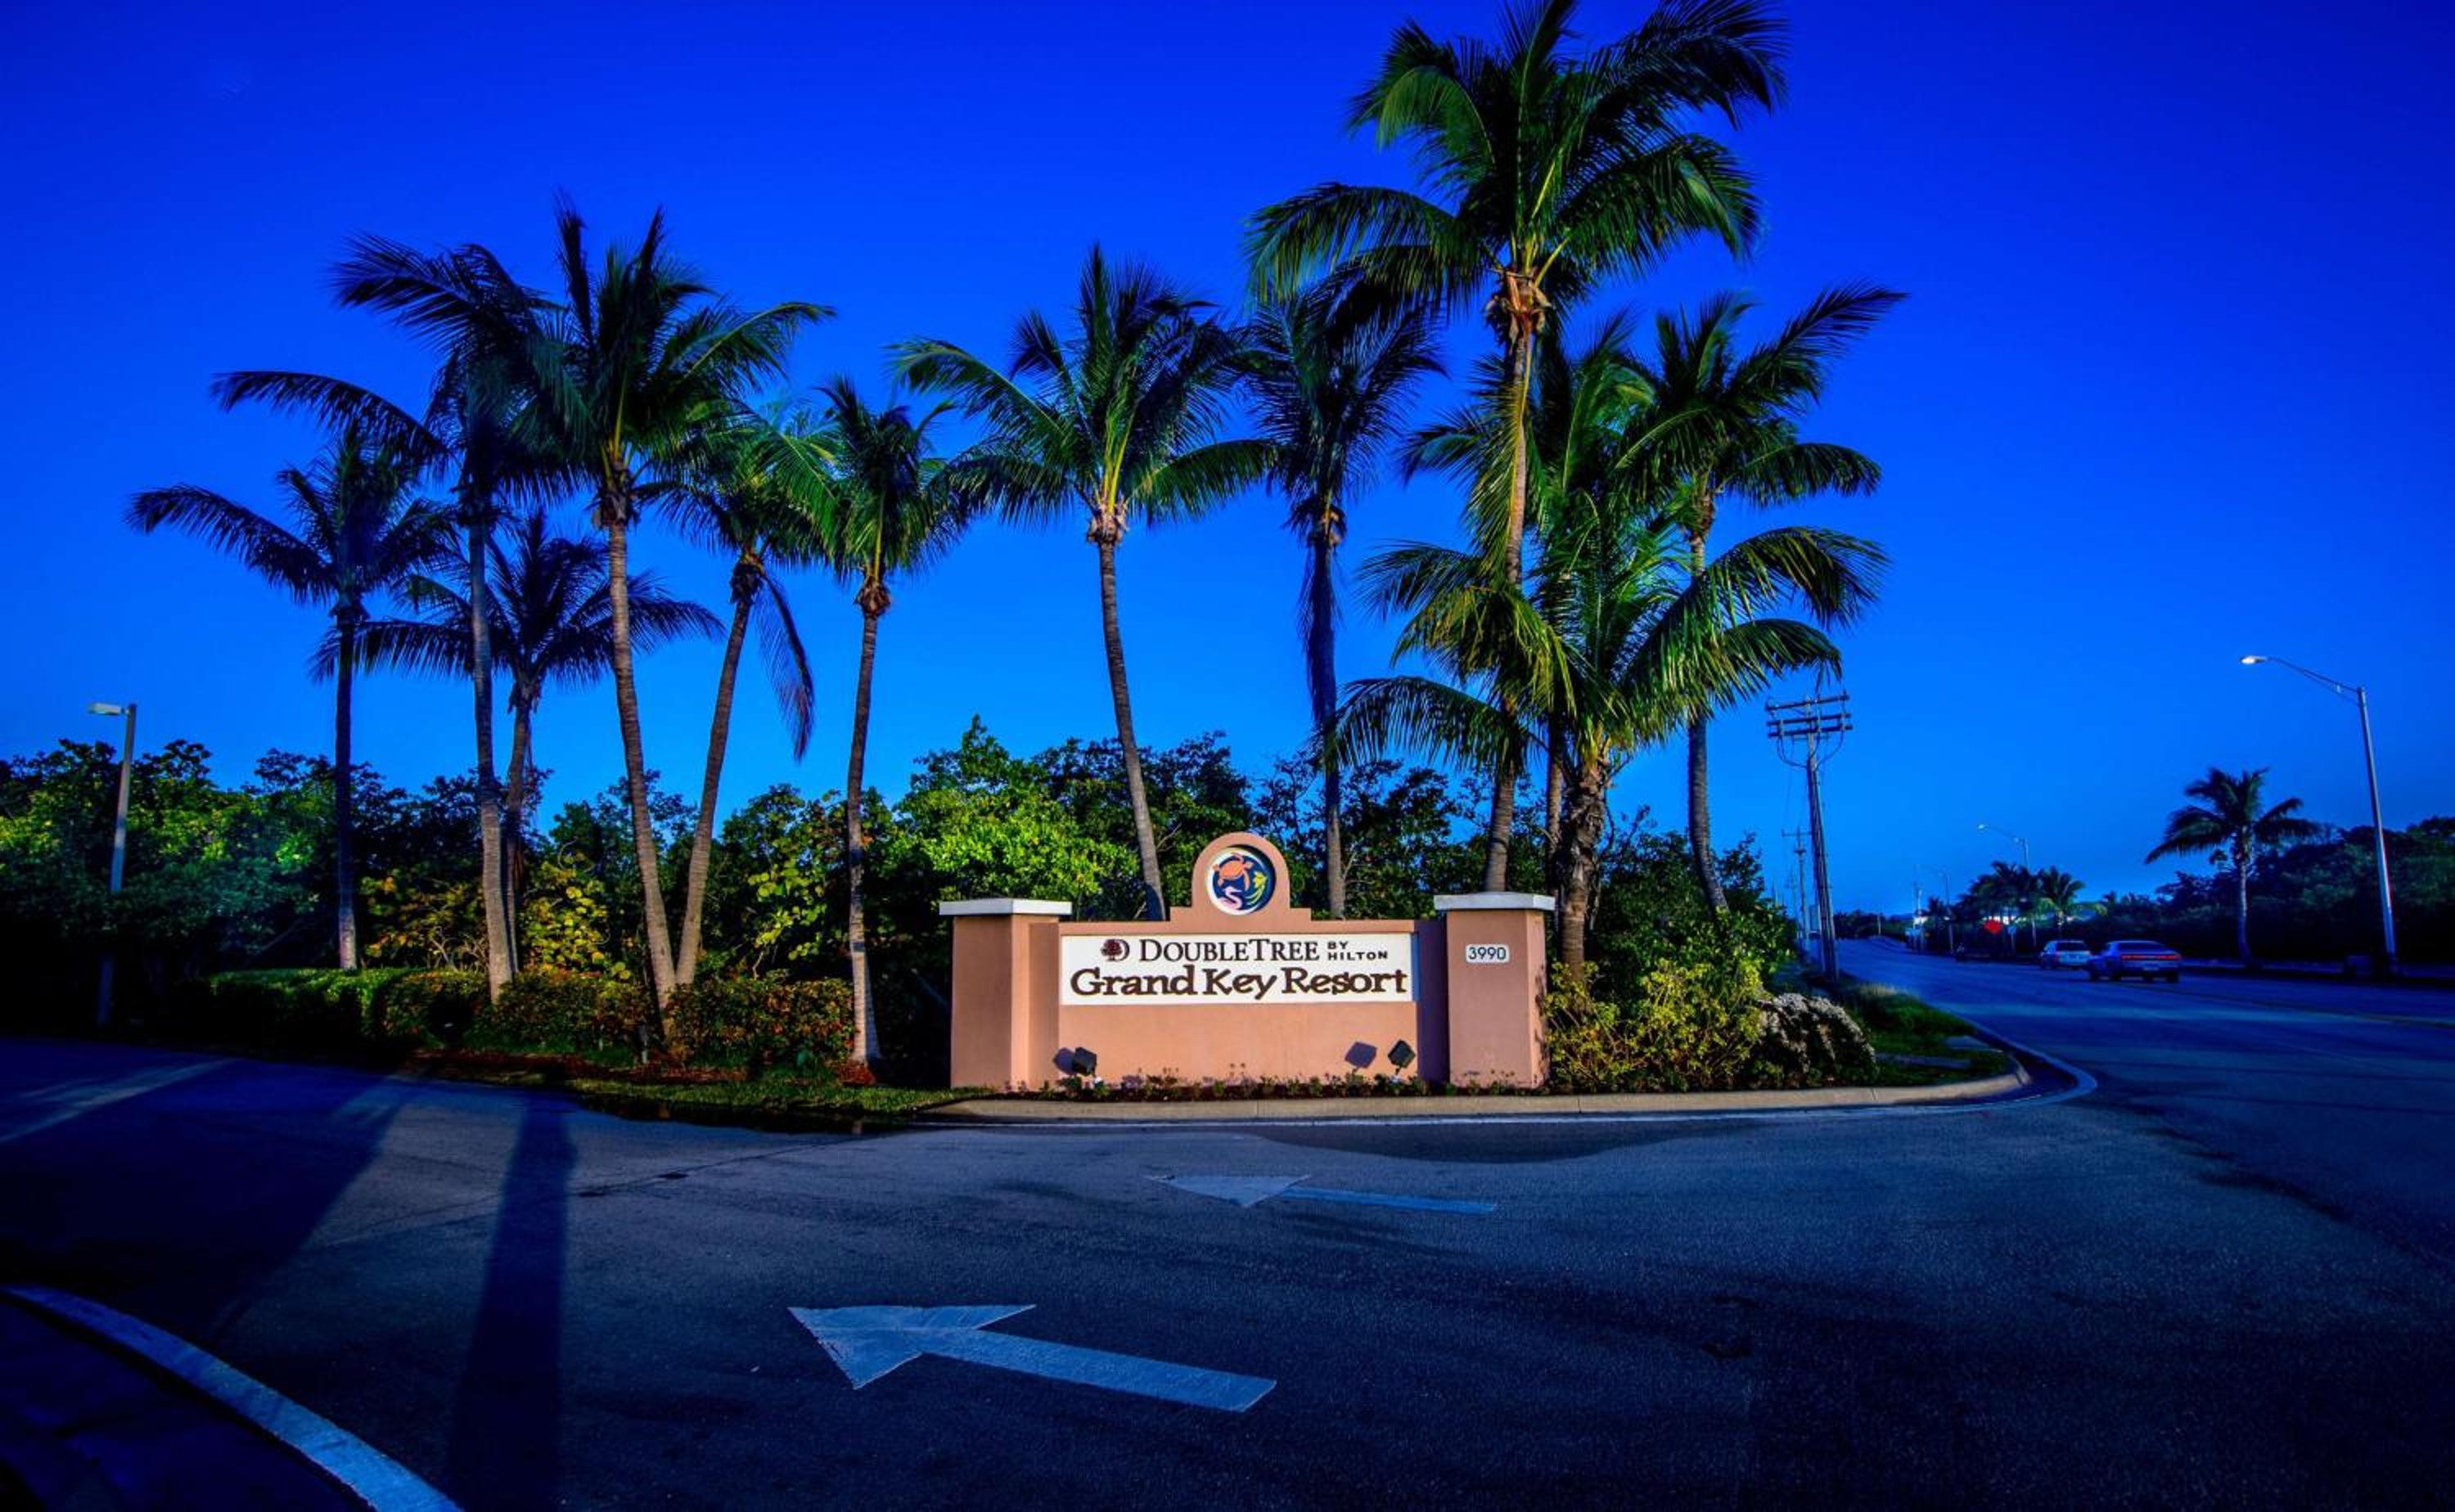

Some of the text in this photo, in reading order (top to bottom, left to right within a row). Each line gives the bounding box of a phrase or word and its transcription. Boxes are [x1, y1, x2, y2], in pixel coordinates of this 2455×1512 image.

[1139, 938, 1320, 962] DOUBLETREE
[1327, 941, 1349, 950] BY
[1327, 951, 1388, 961] HILTON
[1468, 947, 1507, 960] 3990
[1070, 964, 1408, 1001] Grand Key Resort
